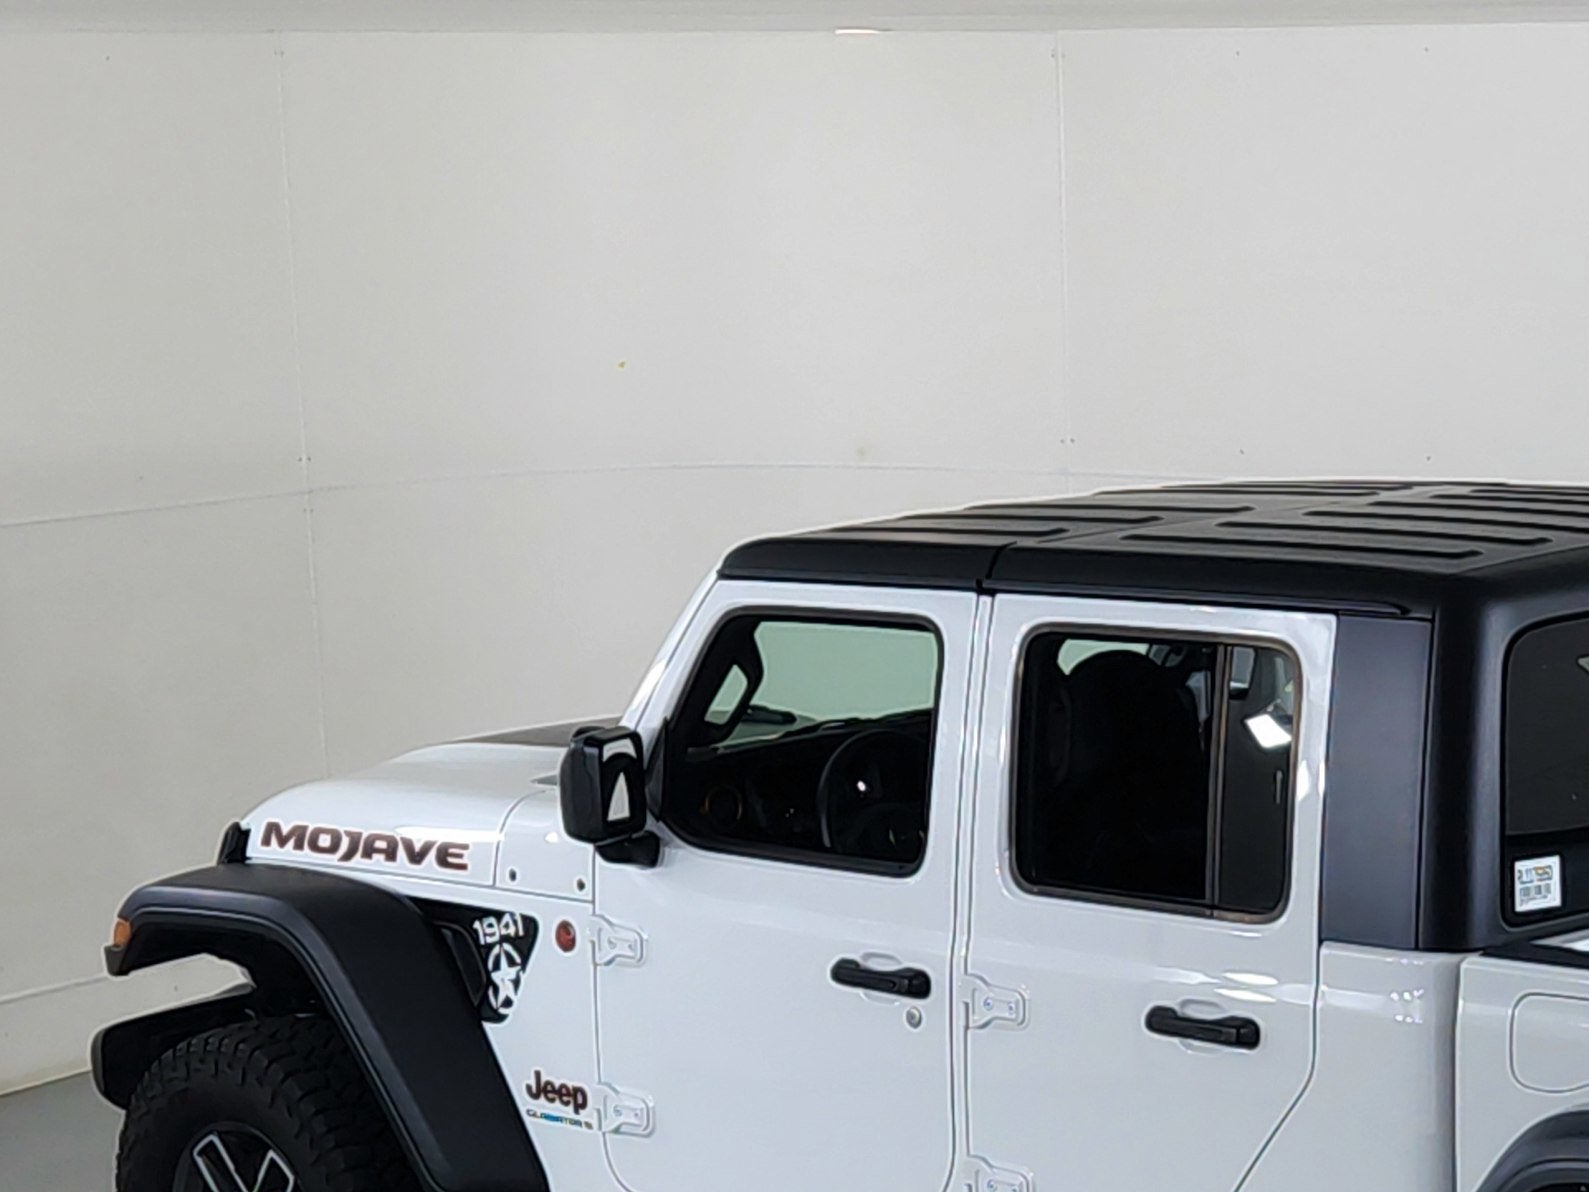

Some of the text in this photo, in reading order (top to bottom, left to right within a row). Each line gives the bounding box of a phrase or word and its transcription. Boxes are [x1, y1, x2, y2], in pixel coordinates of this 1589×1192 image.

[262, 821, 470, 870] MOJAVE
[473, 912, 525, 945] 1941
[525, 1070, 587, 1115] Jeep
